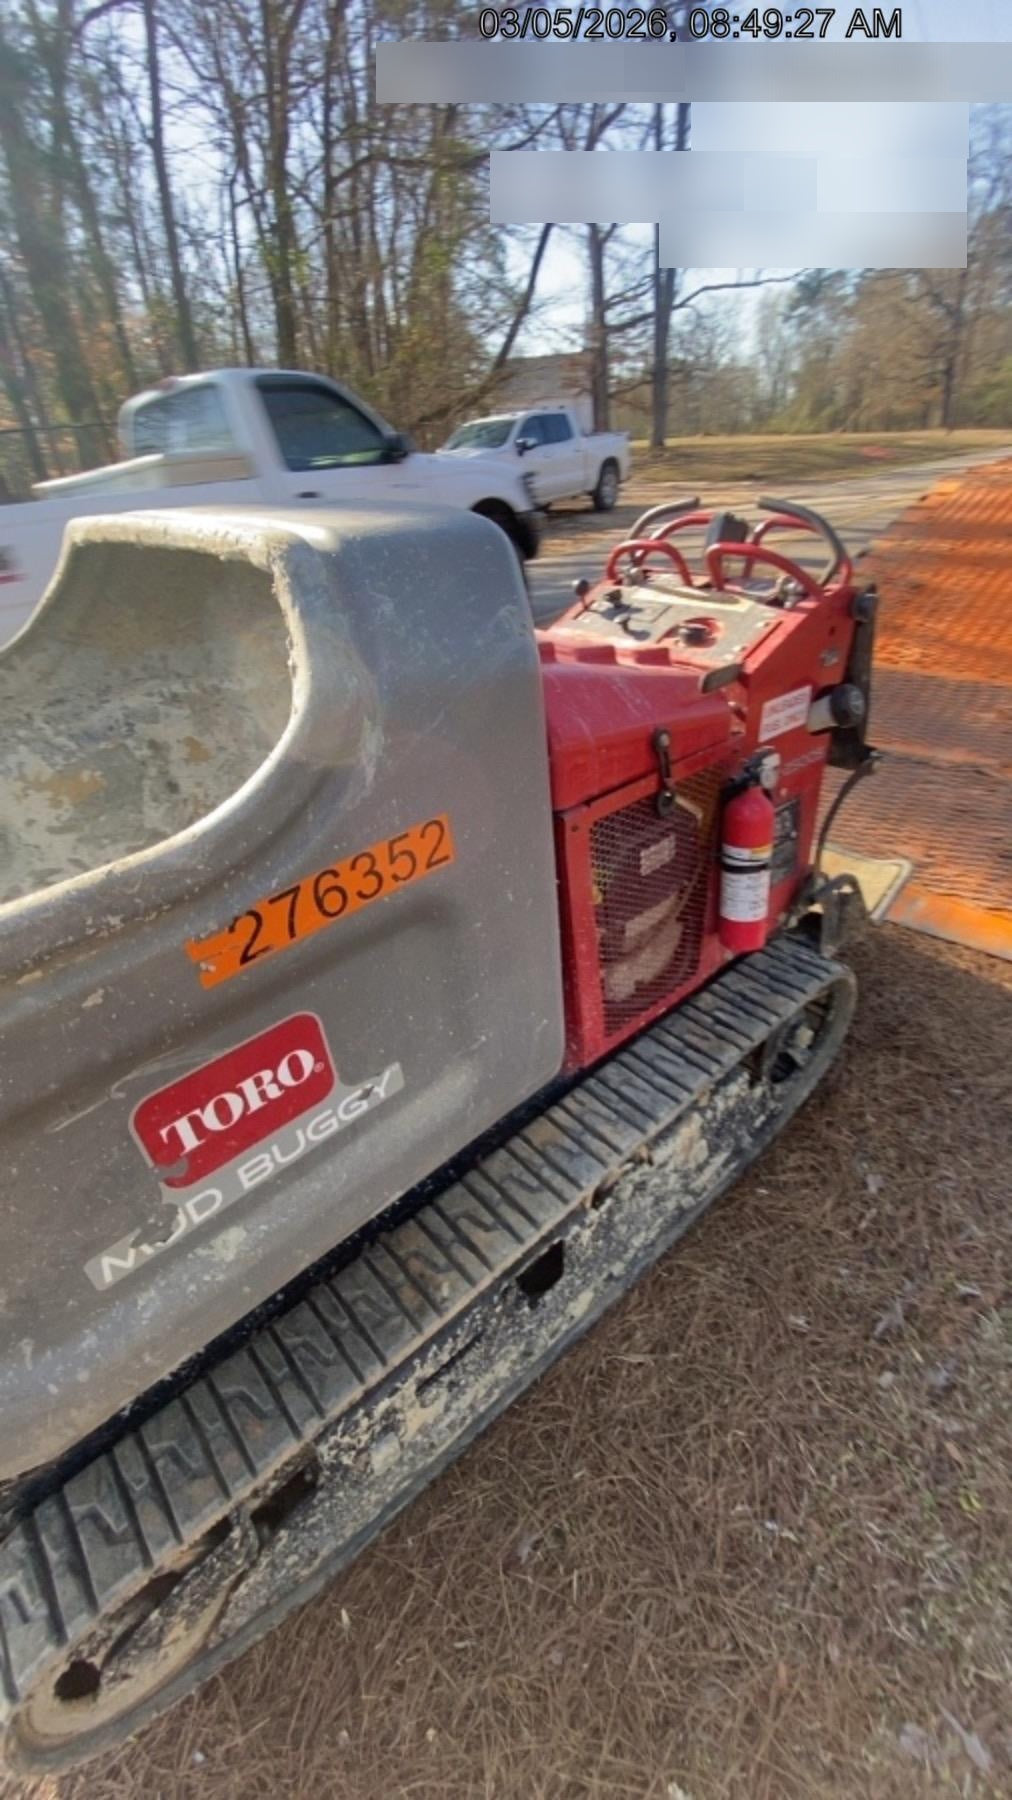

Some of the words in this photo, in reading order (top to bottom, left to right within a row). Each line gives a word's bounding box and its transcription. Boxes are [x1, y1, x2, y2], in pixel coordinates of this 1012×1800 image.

[228, 819, 450, 966] 276352
[159, 1049, 315, 1157] TORO
[237, 1062, 399, 1190] BUGGY
